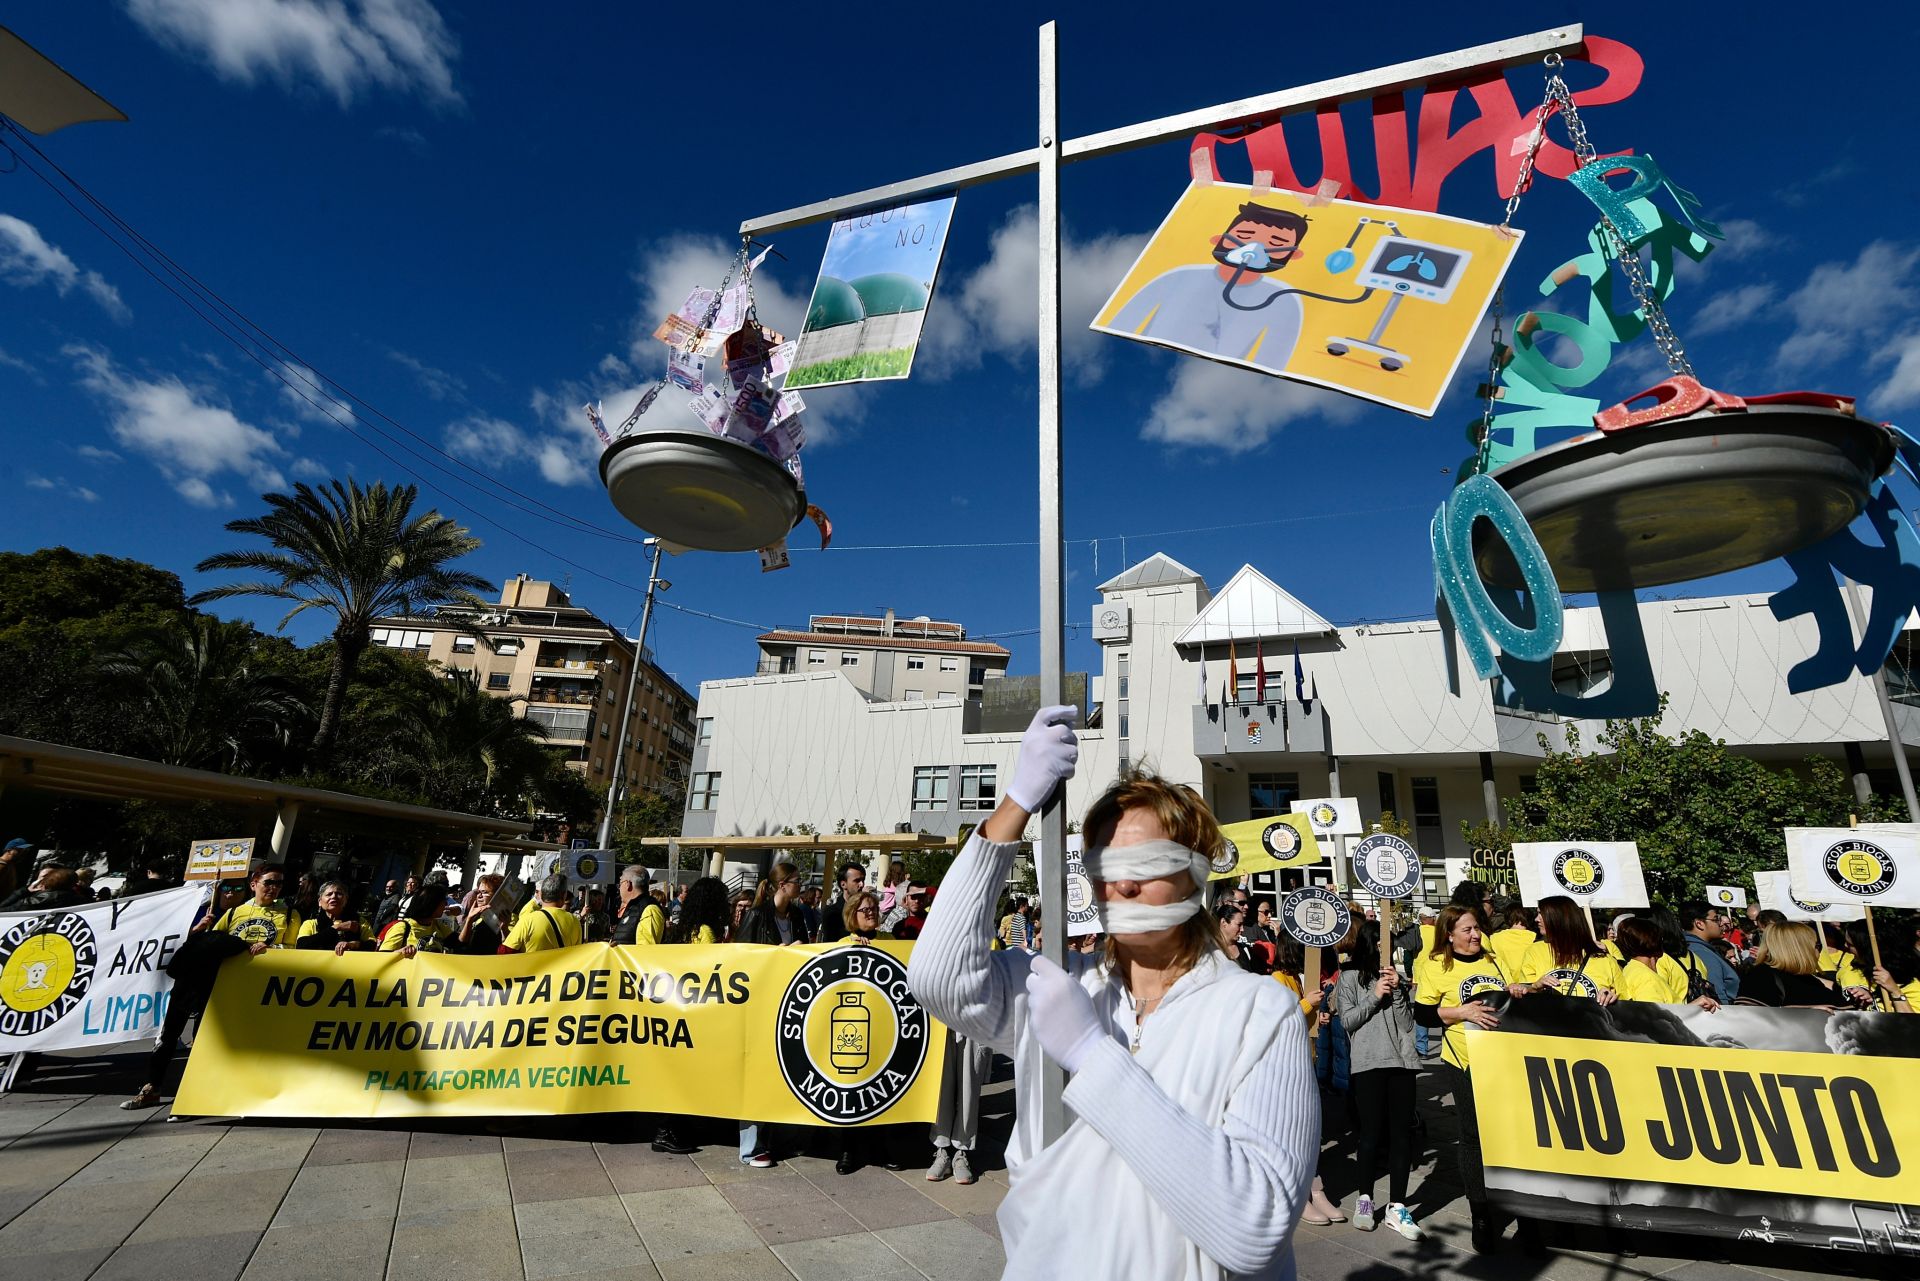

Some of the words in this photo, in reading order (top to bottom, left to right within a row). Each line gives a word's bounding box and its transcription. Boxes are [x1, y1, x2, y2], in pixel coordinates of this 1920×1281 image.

[895, 220, 941, 251] NO!
[1356, 840, 1373, 867] STOP
[1556, 854, 1567, 875] STOP
[1827, 846, 1844, 870] STOP
[1364, 878, 1413, 896] MOLINA
[1564, 881, 1599, 893] MOLINA
[1839, 879, 1889, 893] MOLINA
[1067, 904, 1098, 922] OLINA
[1285, 892, 1303, 917] STOP
[1293, 927, 1341, 944] MOLINA
[56, 913, 96, 993] BIOGAS
[108, 934, 180, 978] AIRE
[261, 976, 324, 1007] NO
[328, 978, 357, 1008] A
[365, 978, 408, 1008] LA
[417, 974, 551, 1008] PLANTA
[559, 969, 611, 1002] DE
[618, 964, 750, 1004] BIOGÁS
[784, 966, 824, 1039] STOP
[846, 955, 922, 1039] BIOGÁS
[307, 1021, 362, 1050] EN
[364, 1020, 494, 1050] MOLINA
[500, 1017, 549, 1048] DE
[555, 1014, 694, 1048] SEGURA
[364, 1068, 521, 1091] PLATAFORMA
[527, 1064, 630, 1088] VECINAL
[799, 1069, 907, 1114] MOLINA
[1524, 1056, 1625, 1156] NO
[1645, 1066, 1901, 1178] JUNTO
